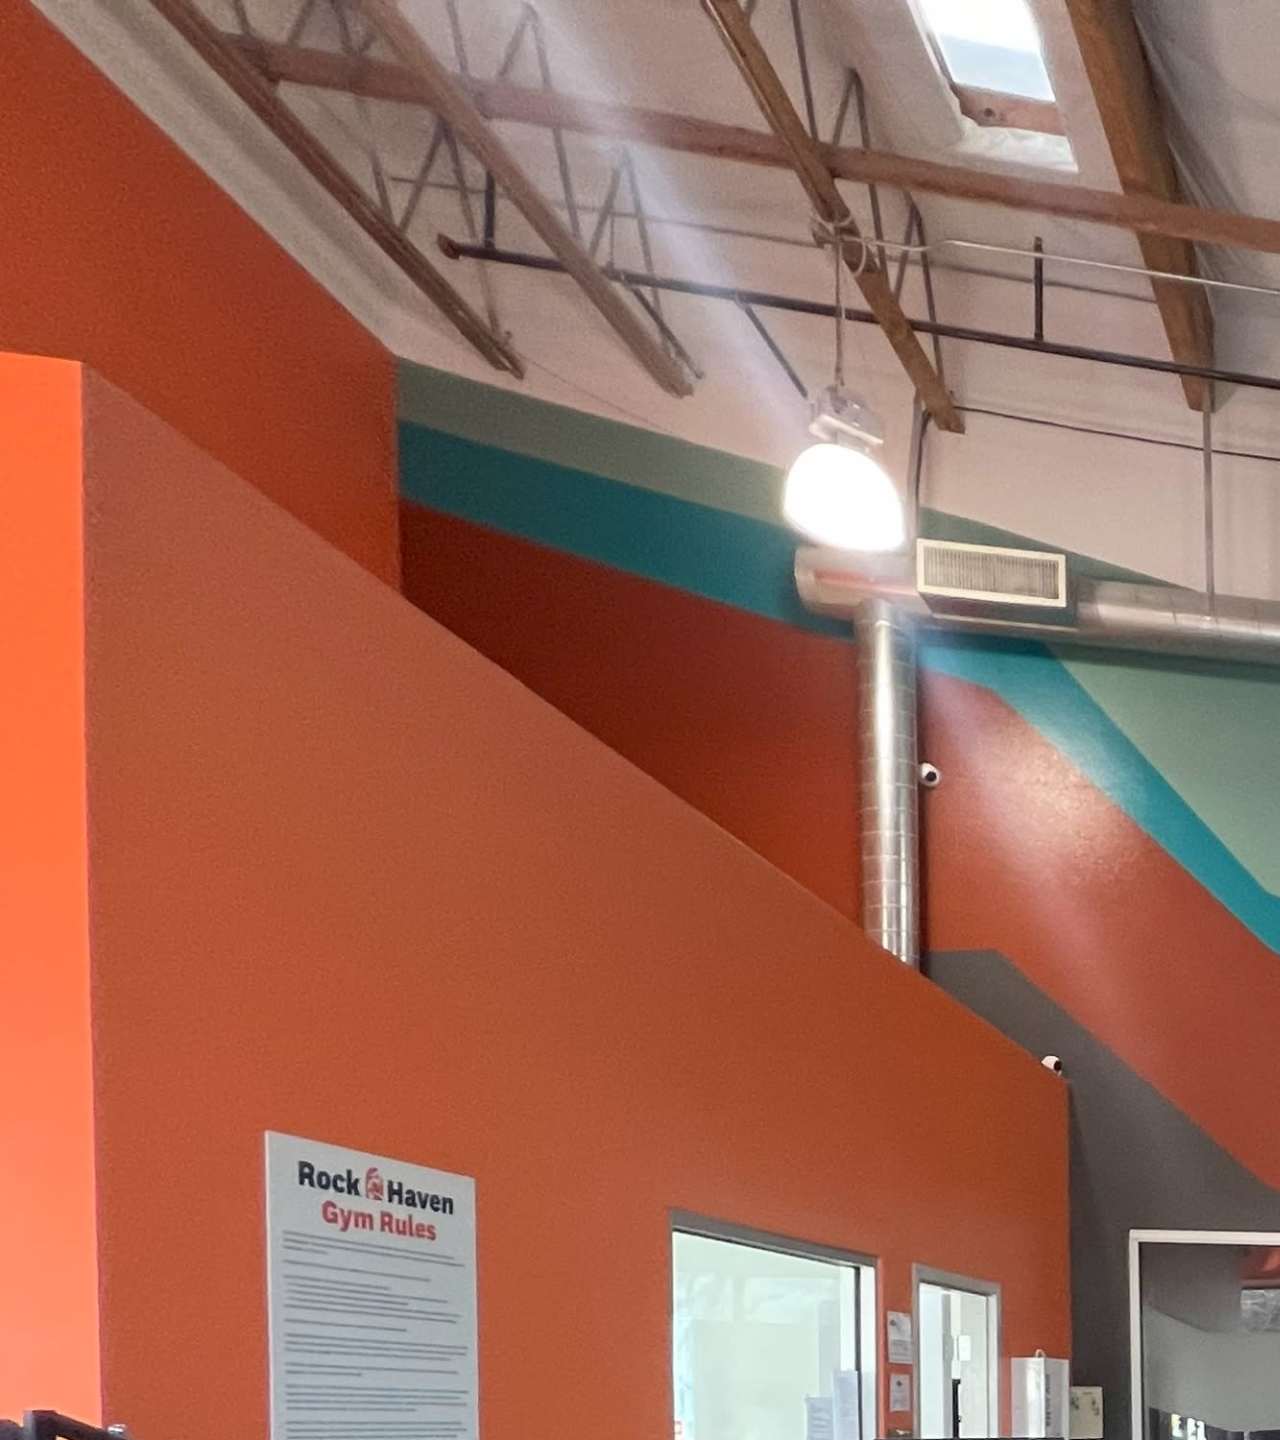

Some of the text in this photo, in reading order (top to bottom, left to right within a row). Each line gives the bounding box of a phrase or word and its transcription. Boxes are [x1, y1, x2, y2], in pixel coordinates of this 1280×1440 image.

[298, 1161, 454, 1215] Rock Haven
[321, 1200, 437, 1241] Gym Rules
